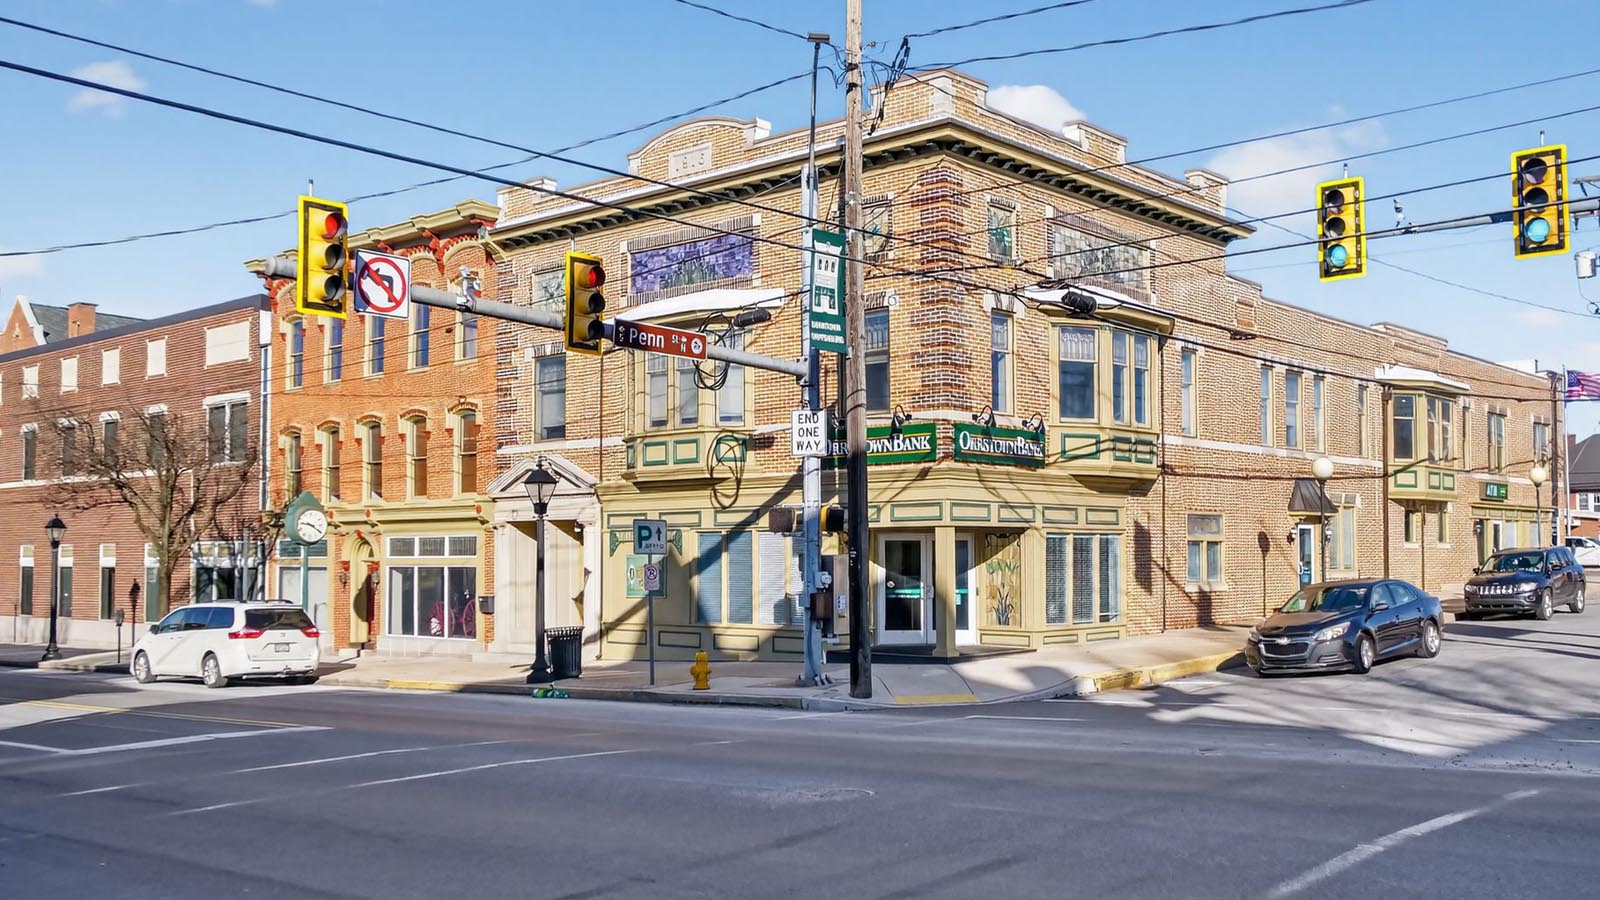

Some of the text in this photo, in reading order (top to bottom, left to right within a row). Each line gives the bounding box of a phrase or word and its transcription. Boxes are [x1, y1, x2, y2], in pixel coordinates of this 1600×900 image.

[629, 328, 665, 349] Penn
[798, 413, 819, 424] END
[798, 427, 819, 437] ONE
[796, 440, 822, 451] WAY
